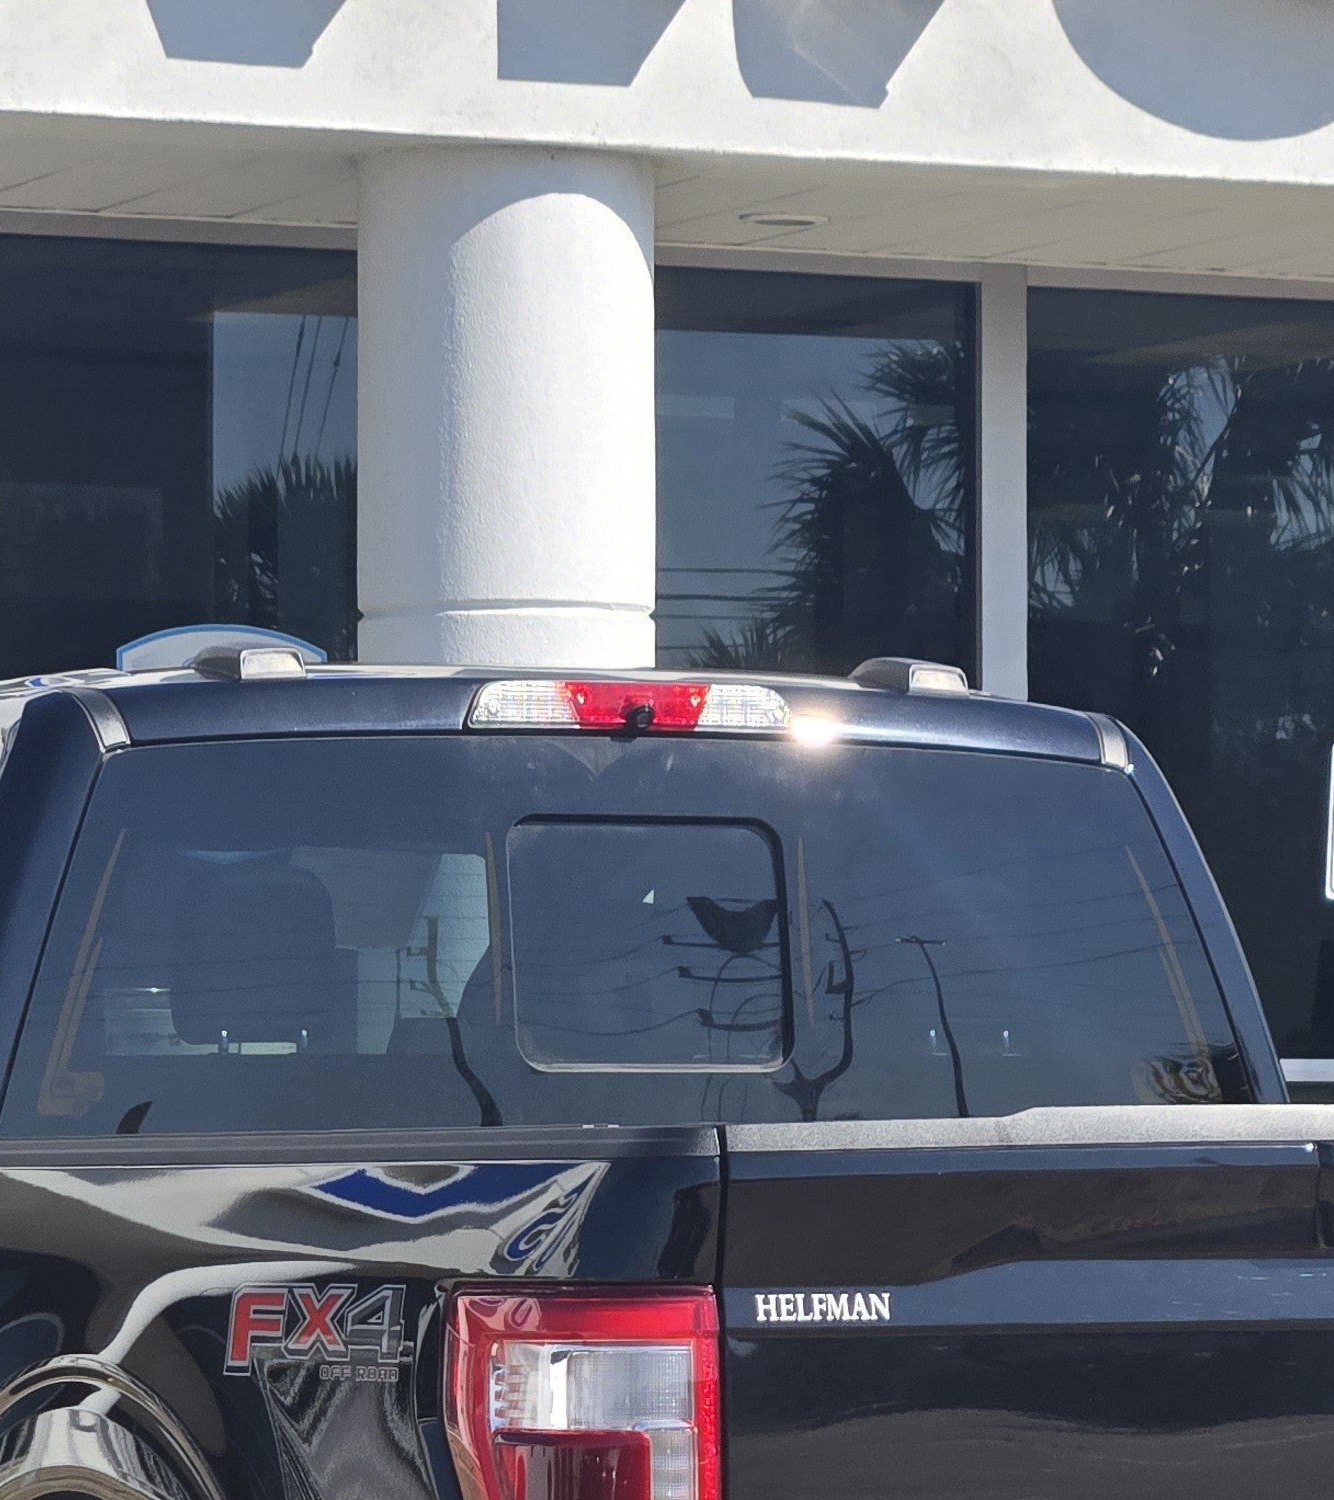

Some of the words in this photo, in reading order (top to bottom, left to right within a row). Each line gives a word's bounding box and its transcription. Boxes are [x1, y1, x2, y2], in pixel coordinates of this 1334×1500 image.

[754, 1292, 891, 1323] HELFMAN
[223, 1283, 405, 1376] FX4
[319, 1366, 352, 1381] OFF
[356, 1366, 399, 1382] ROAD
